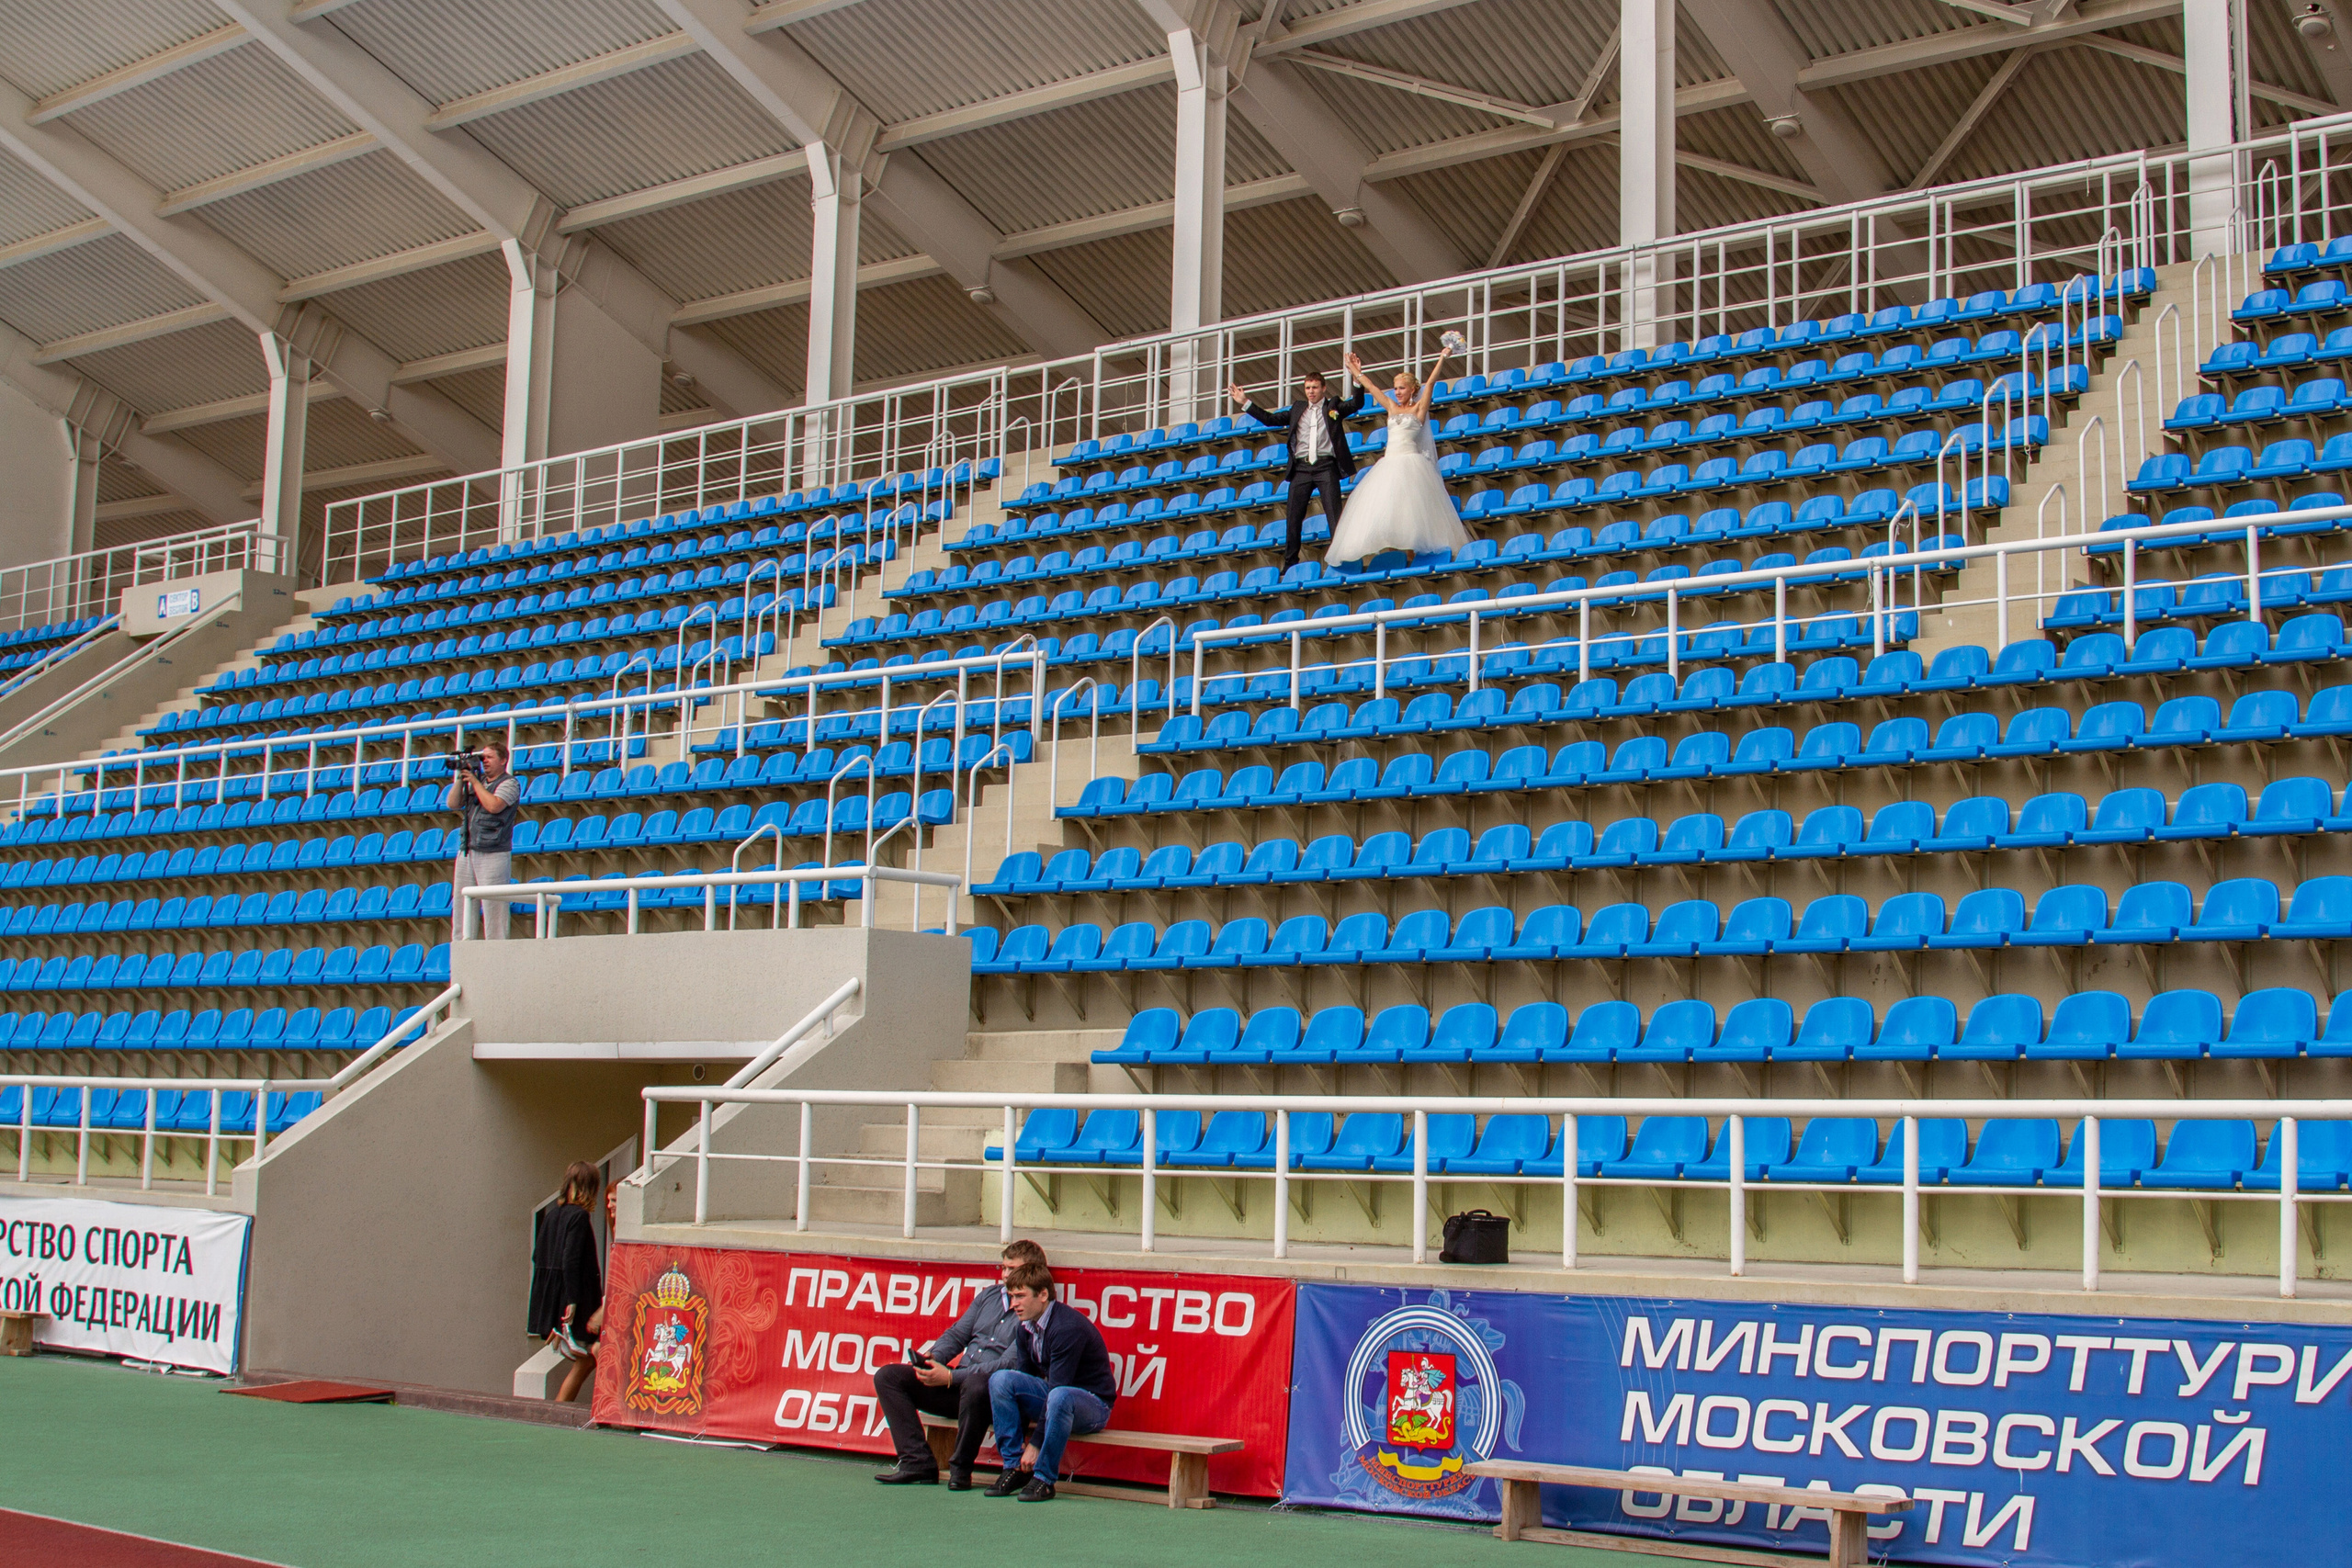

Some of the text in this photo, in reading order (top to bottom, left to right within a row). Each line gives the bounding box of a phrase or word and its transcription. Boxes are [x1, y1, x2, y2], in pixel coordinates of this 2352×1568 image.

[84, 1226, 193, 1275] СПОРТА
[0, 1272, 220, 1343] ОЙ ФЕДЕРАЦИИ
[1621, 1391, 2267, 1485] МОСКОВСКОЙ
[1358, 1454, 1431, 1499] МОСКОВСКОЙ
